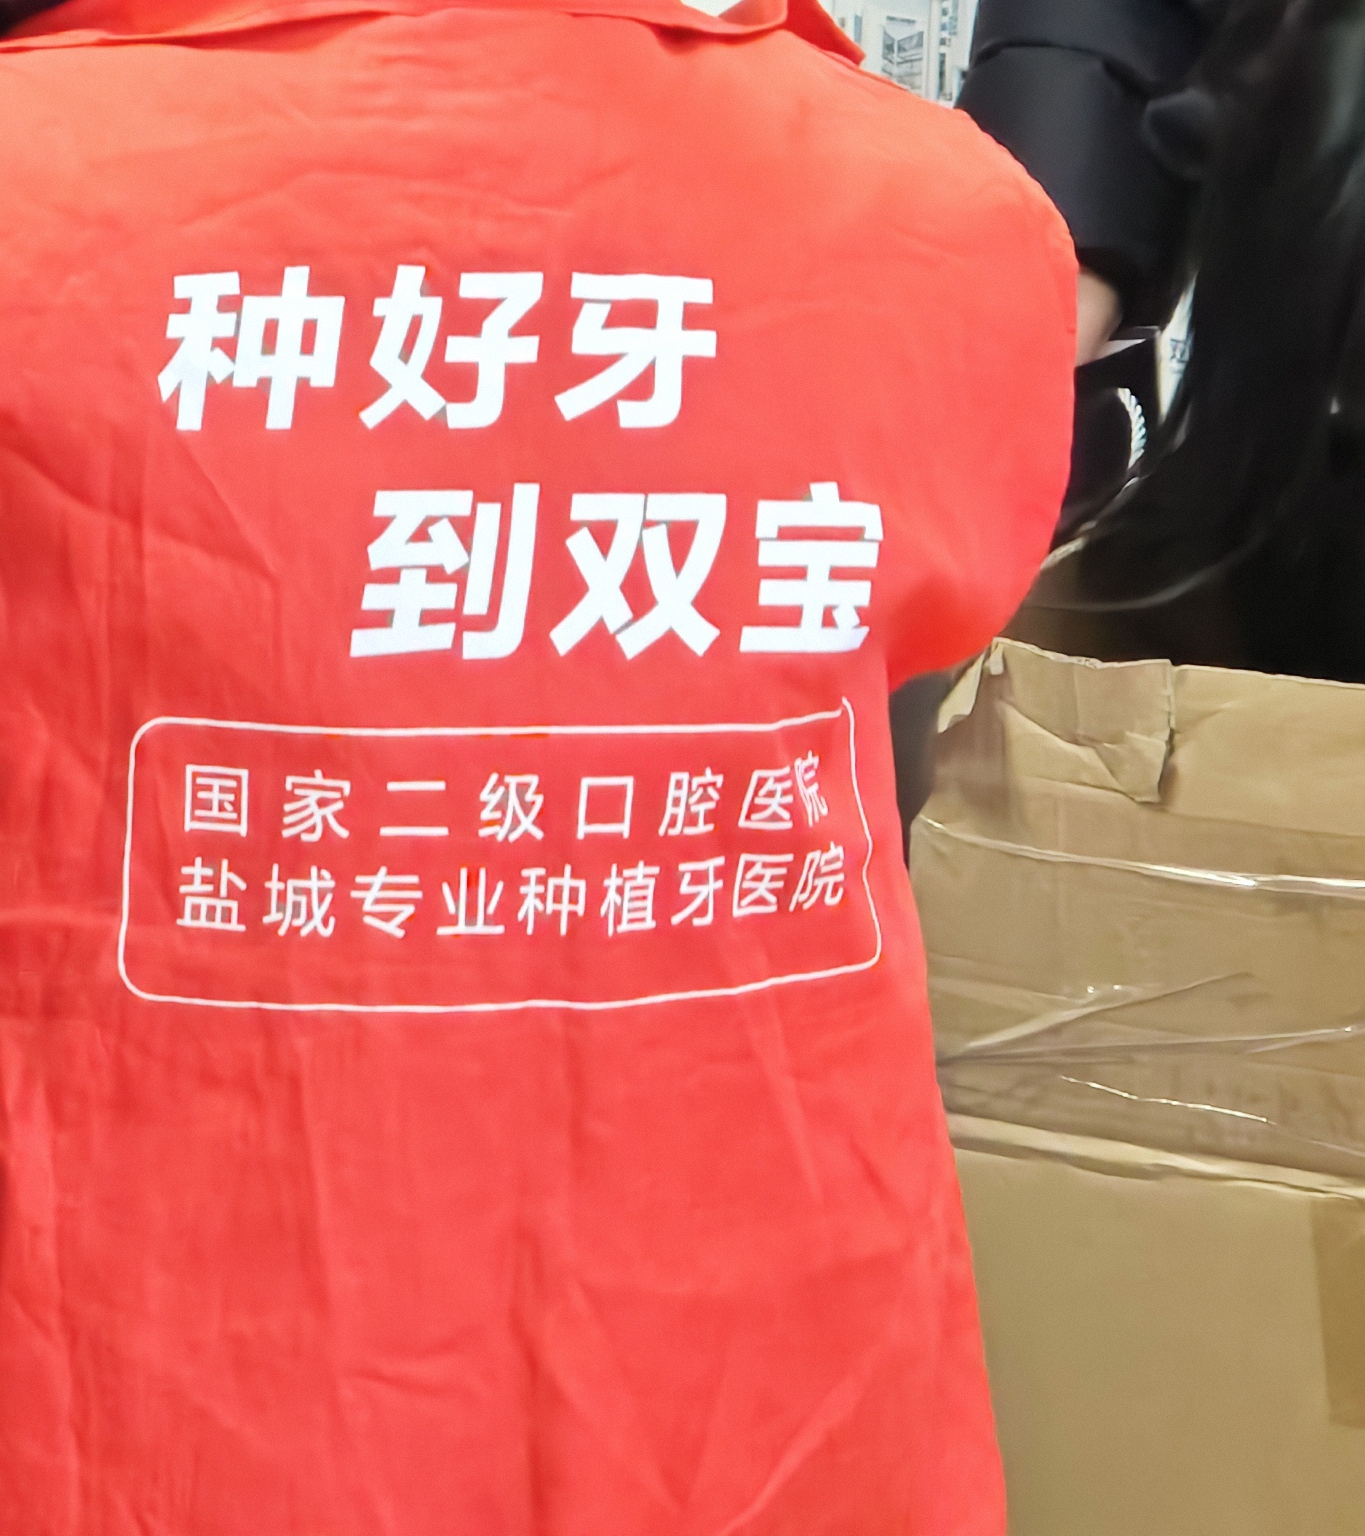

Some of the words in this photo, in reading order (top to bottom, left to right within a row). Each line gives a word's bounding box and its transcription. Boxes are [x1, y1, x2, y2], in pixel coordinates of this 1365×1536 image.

[158, 265, 717, 431] 种好牙
[350, 482, 883, 659] 到双宝
[183, 750, 829, 840] 国家二级口腔医院
[177, 843, 846, 940] 盐城专业种植牙医院
